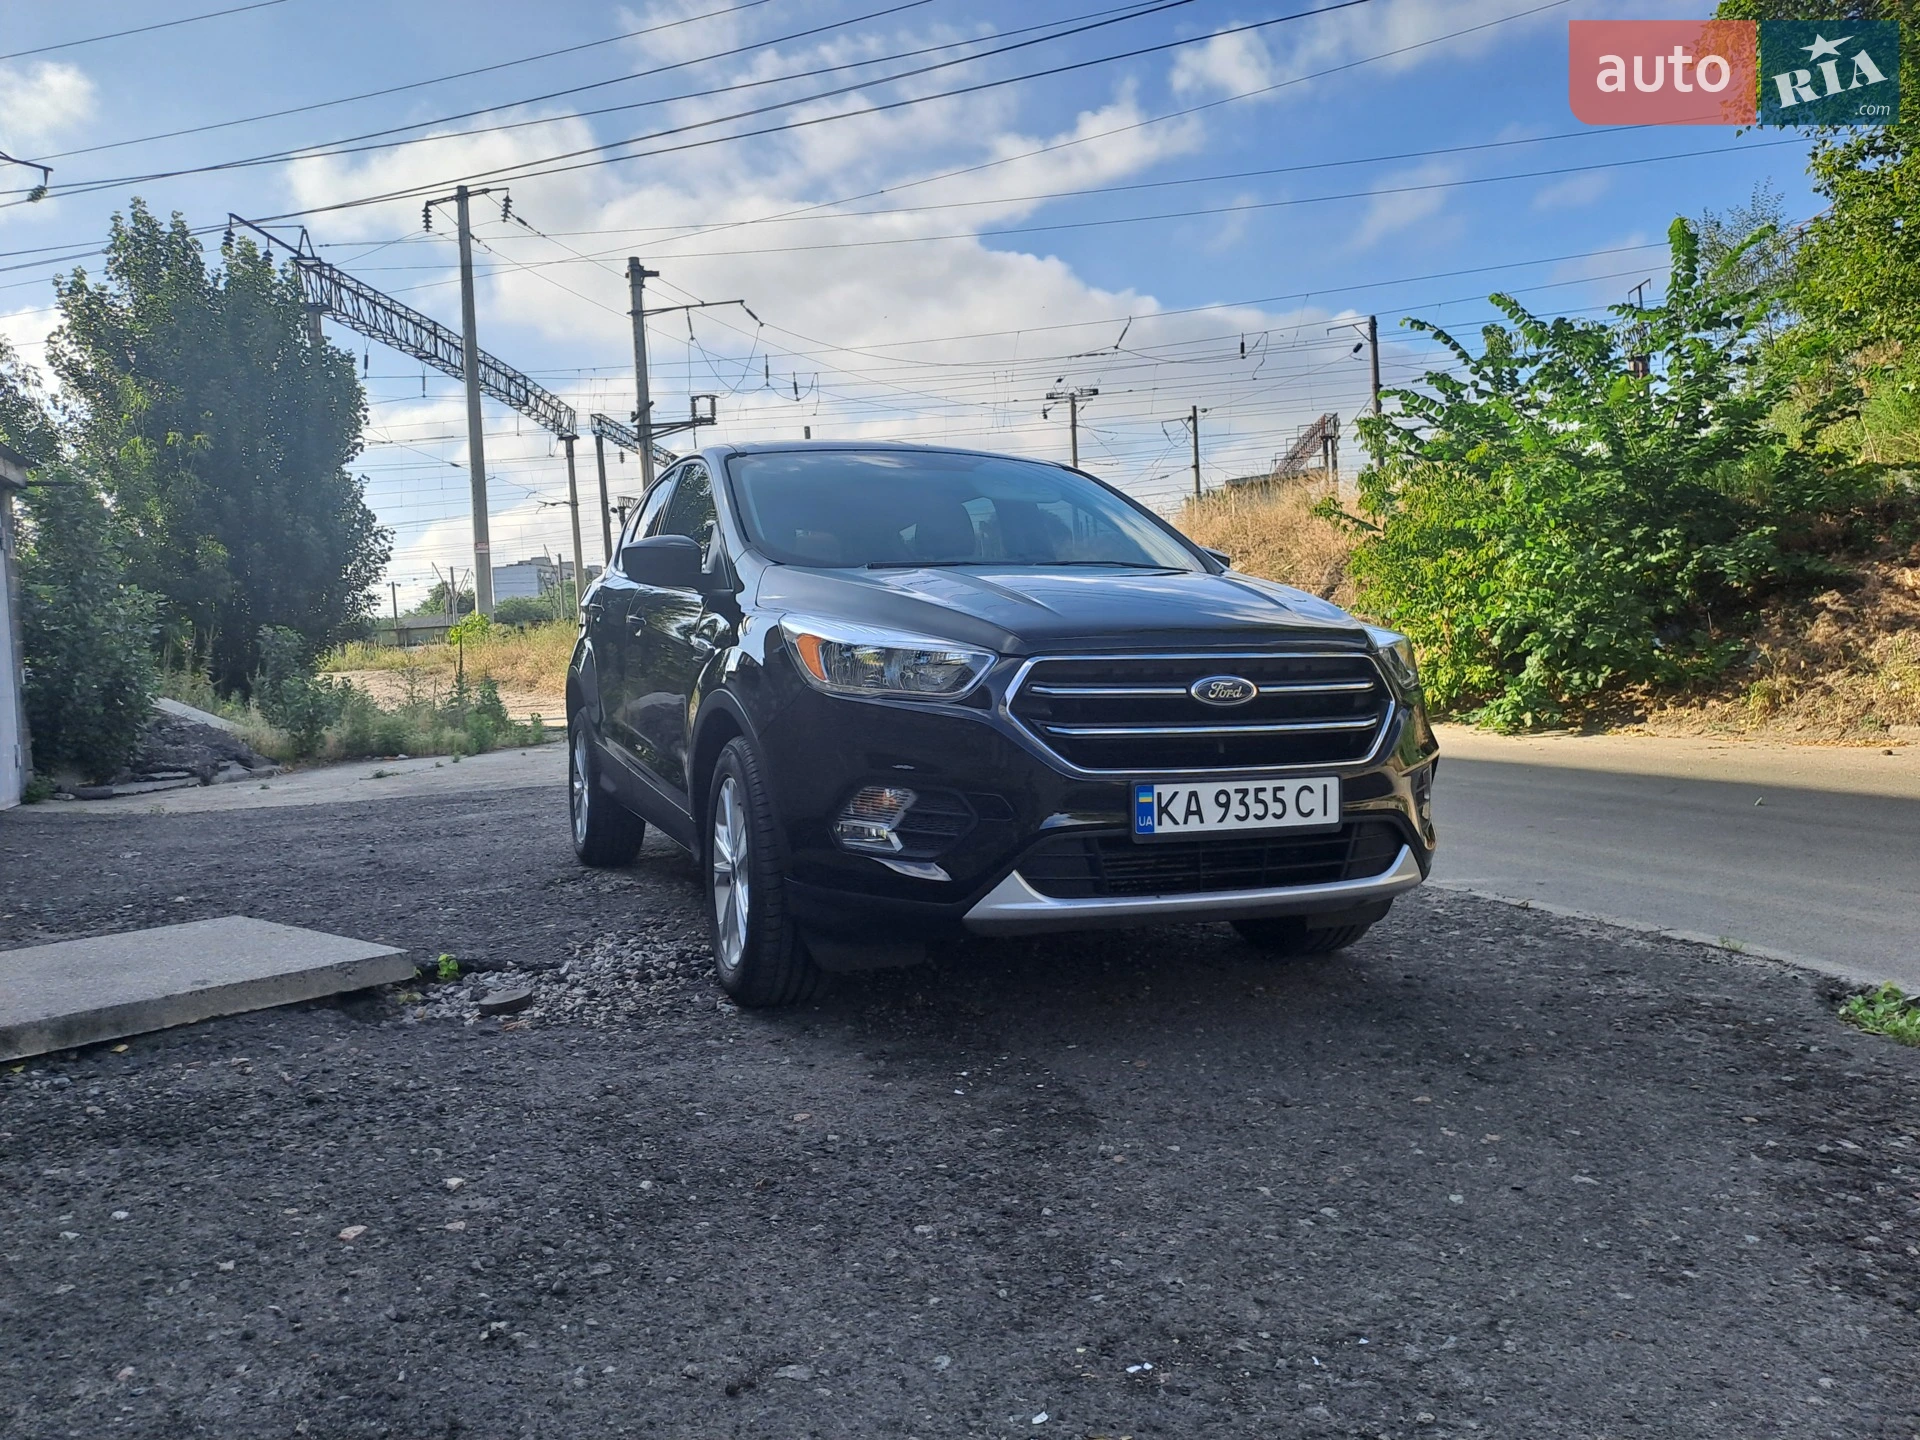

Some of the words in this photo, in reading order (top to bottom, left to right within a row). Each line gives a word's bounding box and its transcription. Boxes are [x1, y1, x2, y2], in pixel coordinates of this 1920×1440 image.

[1208, 681, 1242, 698] Ford
[1156, 790, 1205, 827] KA
[1214, 786, 1287, 823] 9355
[1295, 783, 1328, 818] CI
[1138, 815, 1153, 827] UA
